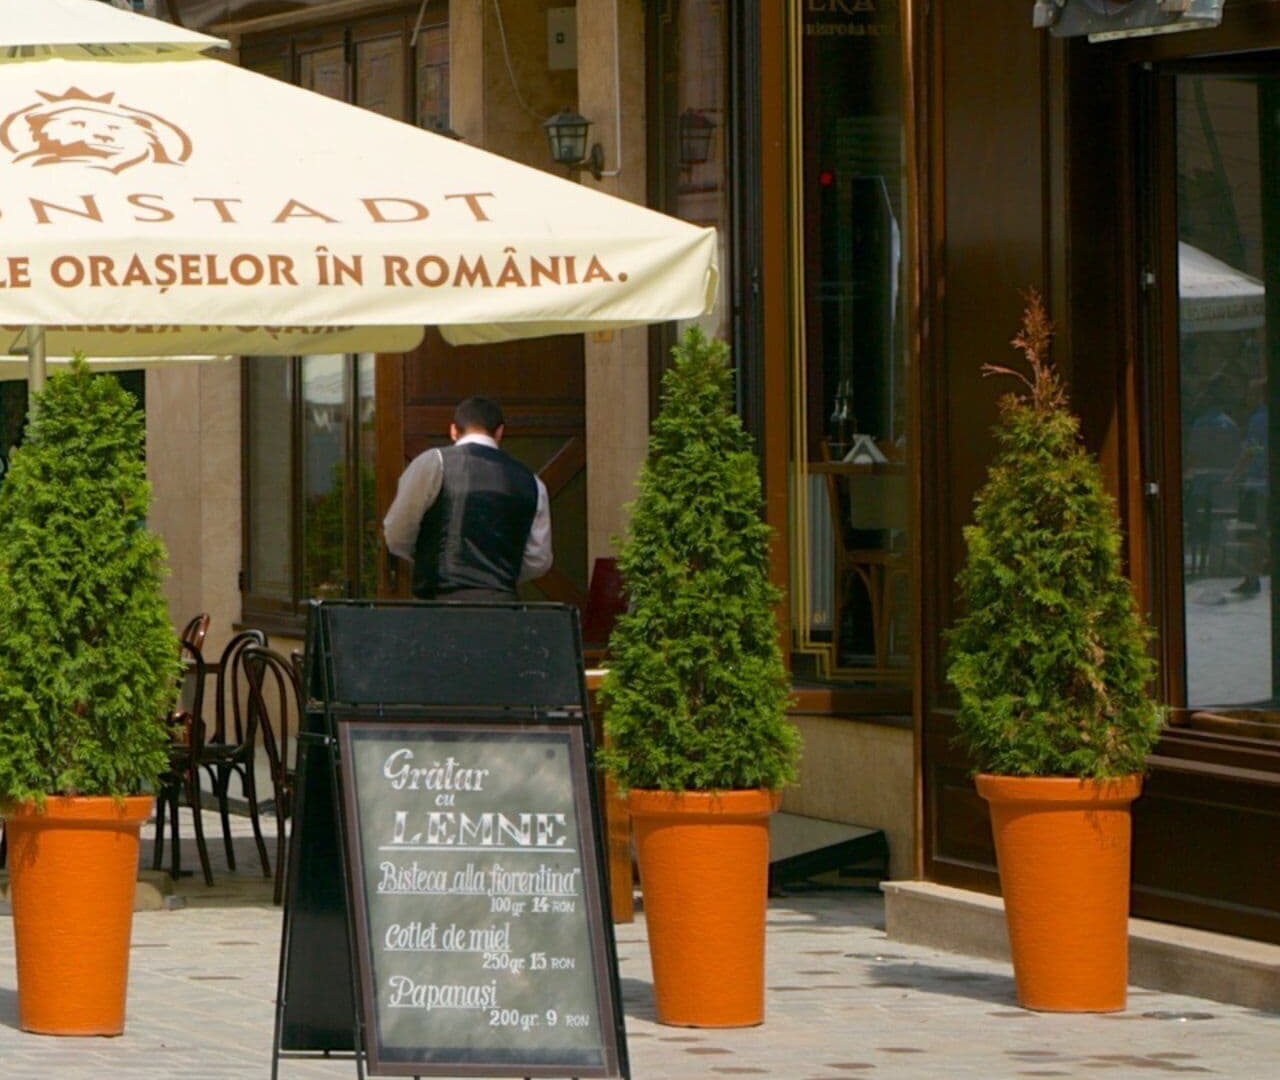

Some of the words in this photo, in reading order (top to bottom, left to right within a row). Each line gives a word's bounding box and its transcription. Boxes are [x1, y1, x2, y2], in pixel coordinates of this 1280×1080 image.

[50, 253, 299, 294] ORAȘELOR
[316, 245, 364, 287] ÎN
[382, 246, 630, 289] ROMÂNIA.
[435, 793, 455, 806] cu
[392, 811, 567, 846] LEMNE
[378, 861, 447, 891] Bisteca
[552, 901, 575, 913] RON
[385, 922, 438, 950] Cotlet
[442, 923, 466, 950] de
[468, 922, 511, 952] miel
[530, 952, 547, 970] 15
[551, 958, 575, 969] RON
[546, 1009, 557, 1026] 9
[566, 1015, 590, 1028] RON
